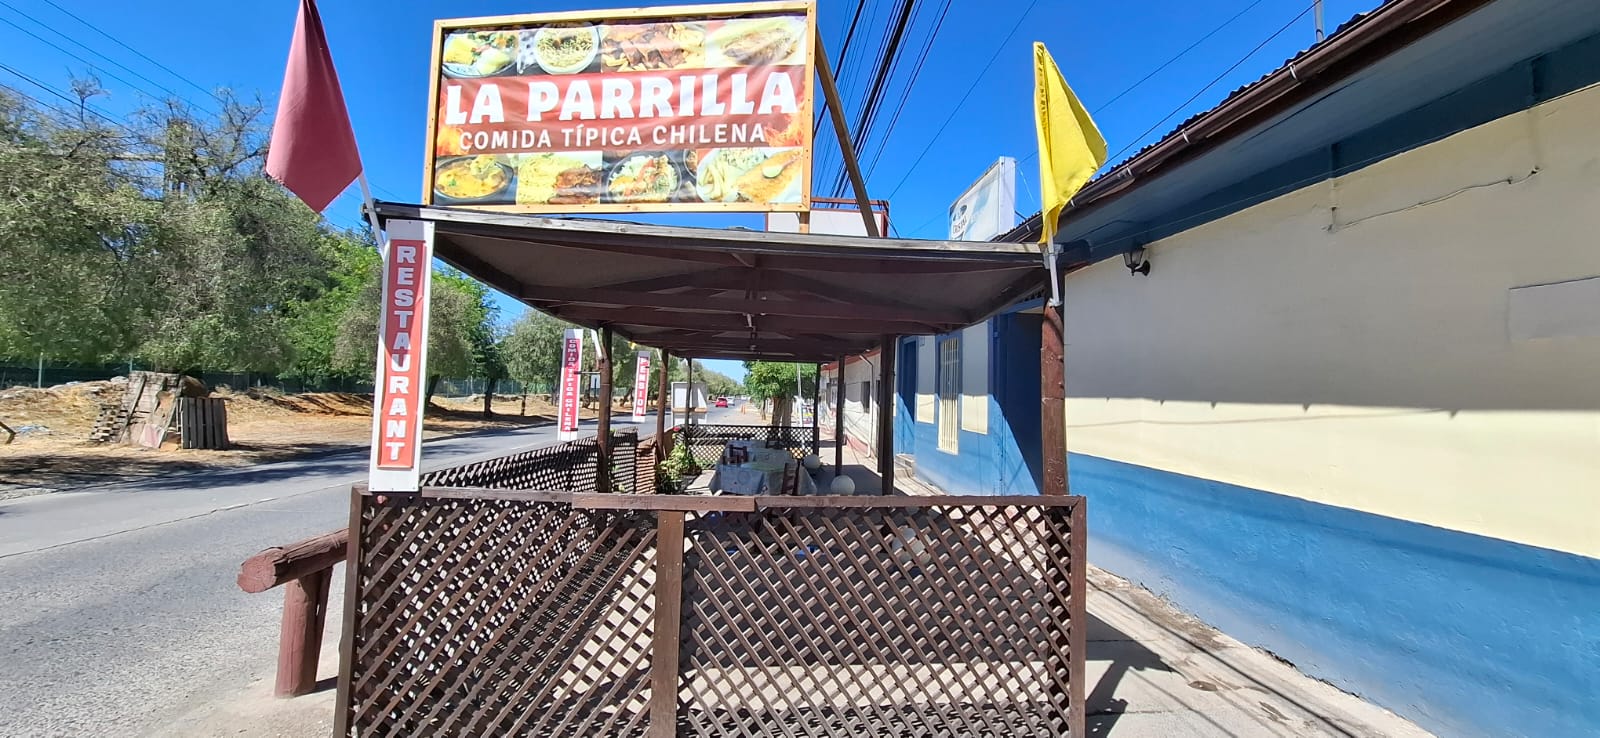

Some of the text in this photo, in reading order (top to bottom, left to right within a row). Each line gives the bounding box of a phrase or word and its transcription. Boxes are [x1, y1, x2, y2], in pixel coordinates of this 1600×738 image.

[445, 72, 798, 125] LA PARRILLA
[459, 123, 767, 151] COMIDA TÍPICA CHILENA
[385, 245, 417, 462] RESTAURANT
[567, 339, 577, 367] COMIDA
[636, 358, 647, 414] PENSION
[564, 399, 573, 431] CHILENA
